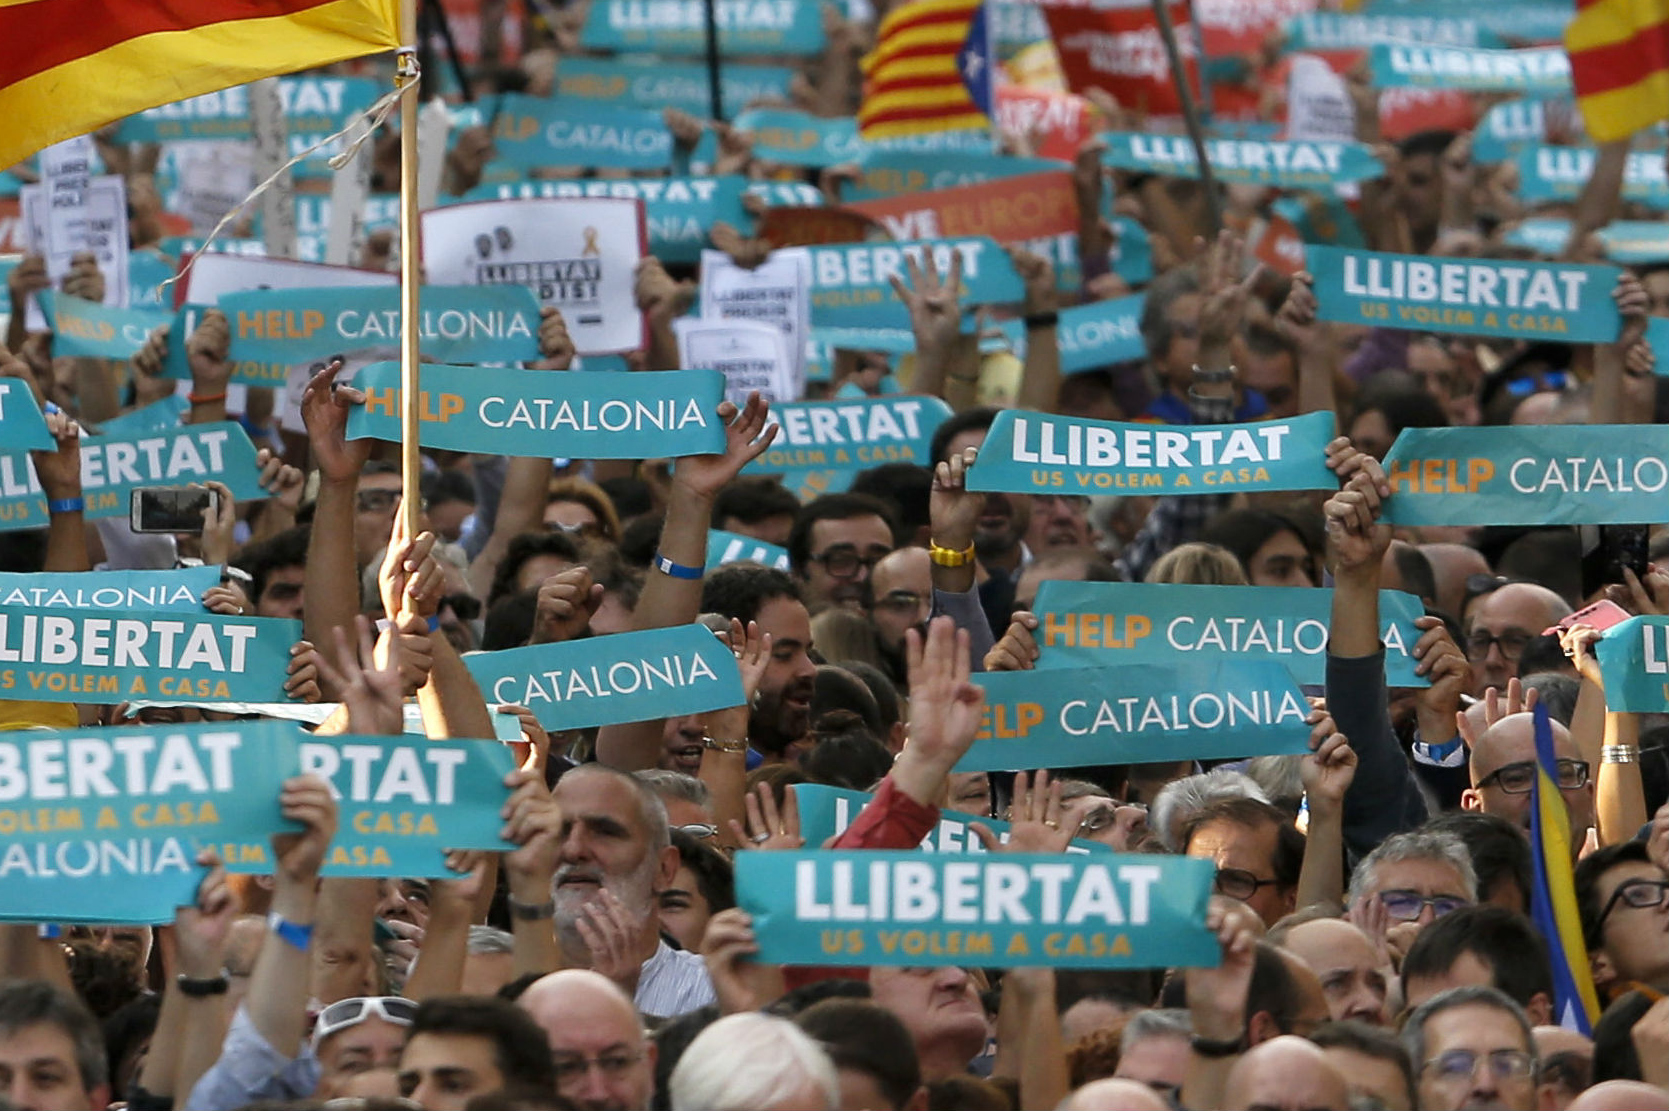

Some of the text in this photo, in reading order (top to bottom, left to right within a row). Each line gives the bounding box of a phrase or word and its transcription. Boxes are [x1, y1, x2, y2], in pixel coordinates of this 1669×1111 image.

[1390, 48, 1570, 75] LLIBERTA
[144, 80, 345, 117] LLIBETAT
[546, 123, 672, 153] CATALON
[1343, 255, 1587, 312] LLIBERTAT
[236, 309, 326, 339] HELP
[1360, 302, 1570, 333] US VOLEM A CASA
[478, 396, 708, 435] CATALONIA
[768, 400, 922, 446] BERTAT
[835, 447, 850, 463] A
[856, 445, 915, 463] CASA
[1012, 417, 1290, 469] LLIBERTAT
[1031, 466, 1270, 489] US VOLEM A CASA
[1389, 458, 1495, 495] HELP
[1044, 612, 1408, 657] HELP CATALOA
[28, 670, 119, 693] VOLEM
[130, 675, 149, 694] A
[158, 677, 231, 699] CASA
[493, 651, 718, 707] CATALONIA
[1060, 689, 1308, 736] CATALONIA
[94, 805, 119, 829] A
[132, 801, 221, 826] CASA
[353, 810, 438, 836] CASA
[795, 860, 1162, 926] LLIBERTAT
[819, 930, 1131, 957] US VOLEM A CASA
